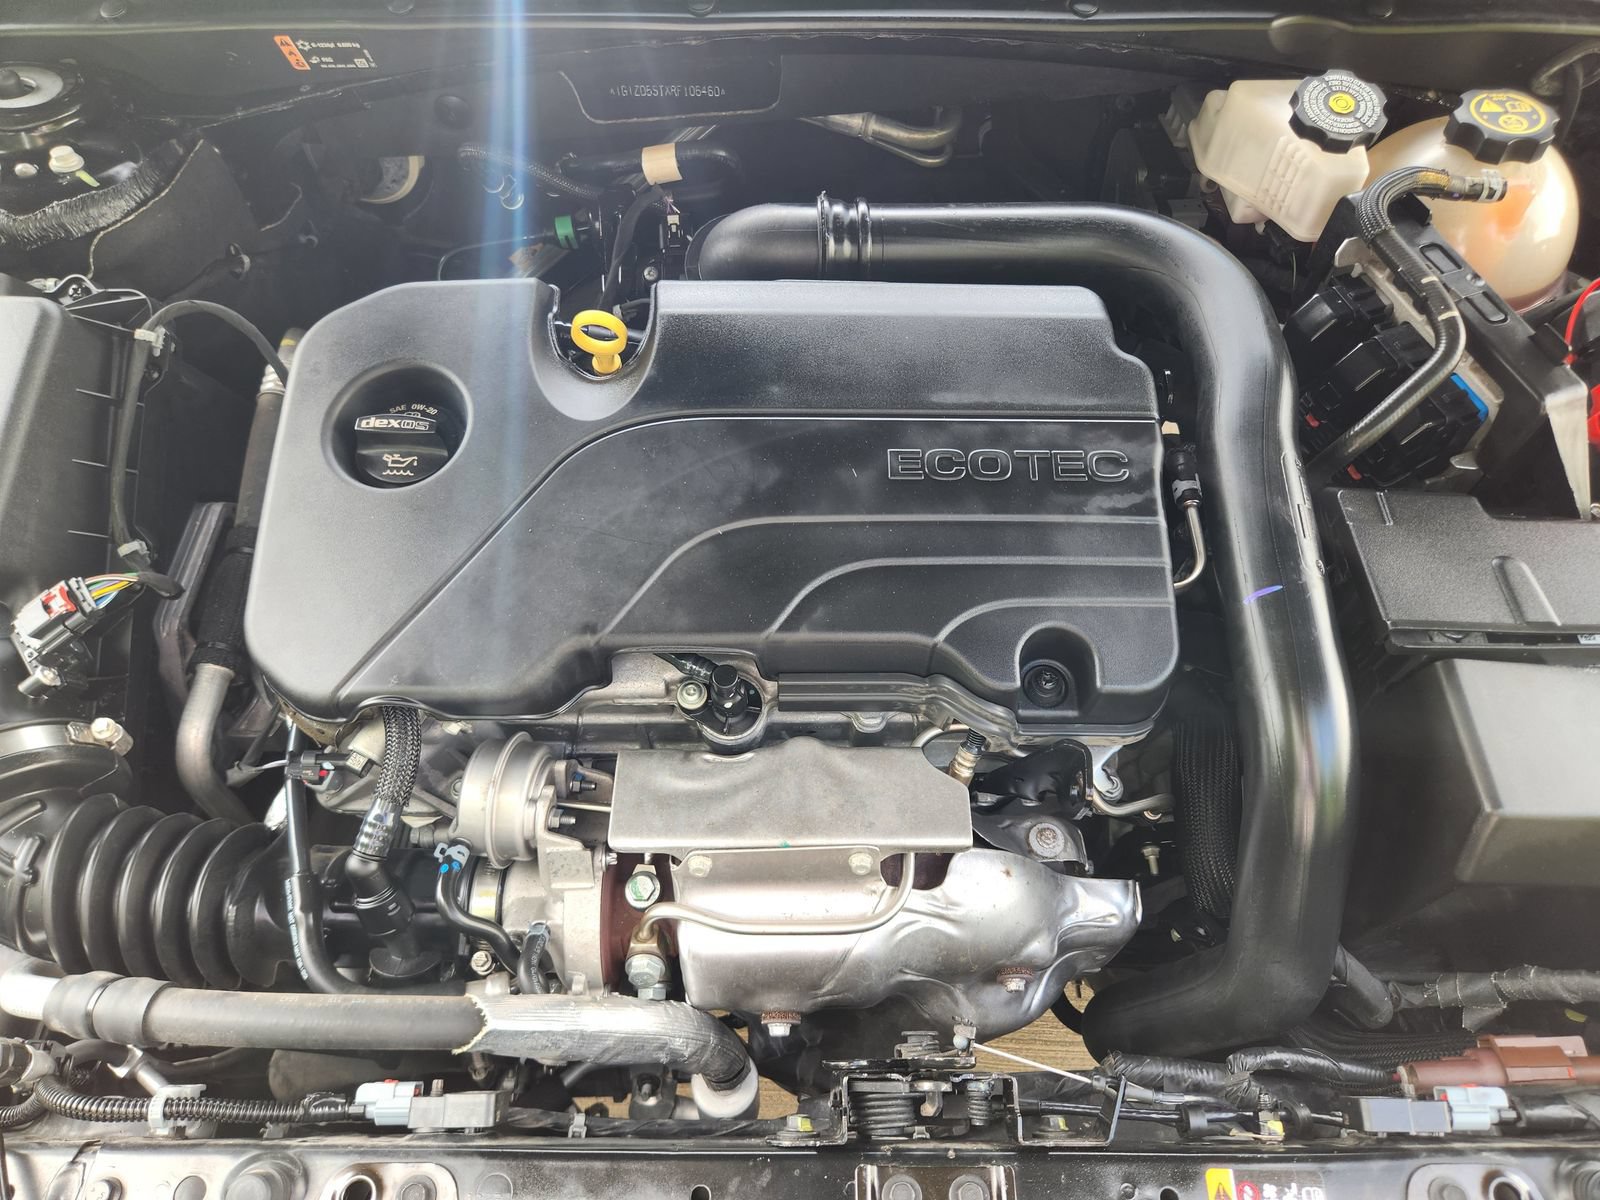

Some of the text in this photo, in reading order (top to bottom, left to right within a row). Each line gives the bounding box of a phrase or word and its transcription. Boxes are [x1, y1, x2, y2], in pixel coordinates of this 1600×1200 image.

[389, 403, 438, 416] SAE 0W-20
[360, 416, 430, 431] dexos
[887, 448, 1130, 483] ECOTEC
